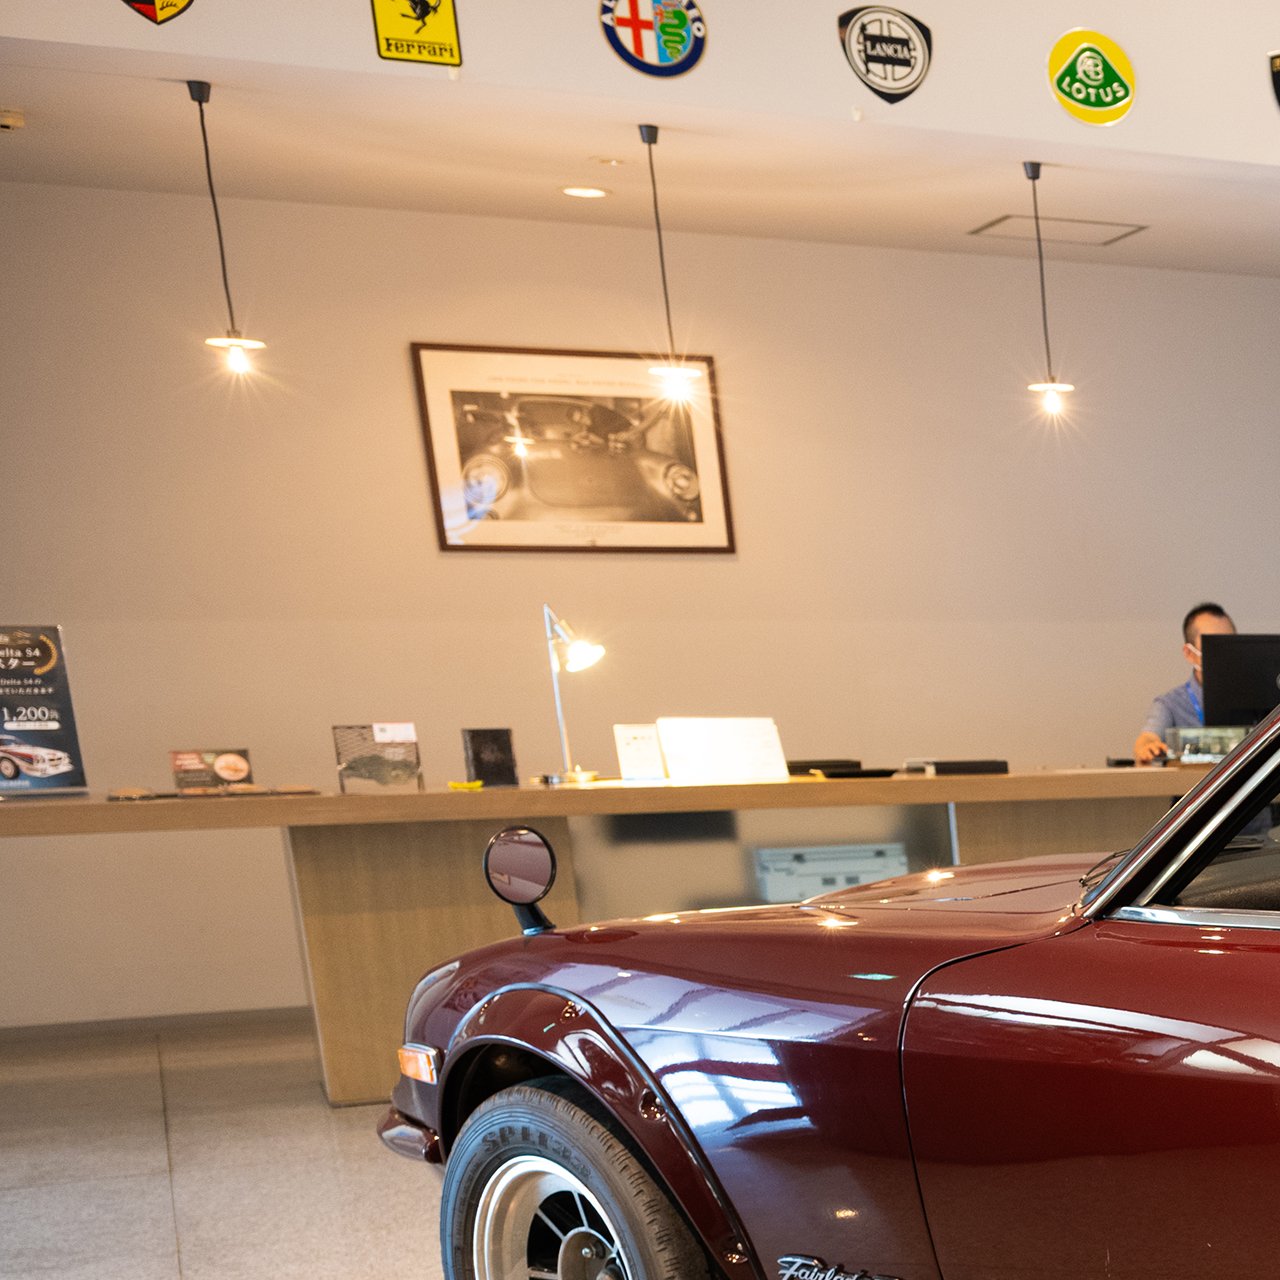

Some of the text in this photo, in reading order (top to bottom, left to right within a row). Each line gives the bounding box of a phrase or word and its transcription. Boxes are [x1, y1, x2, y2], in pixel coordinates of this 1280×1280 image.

[385, 38, 455, 57] Ferrari
[866, 41, 911, 59] LANCIA
[1062, 76, 1125, 102] LOTUS
